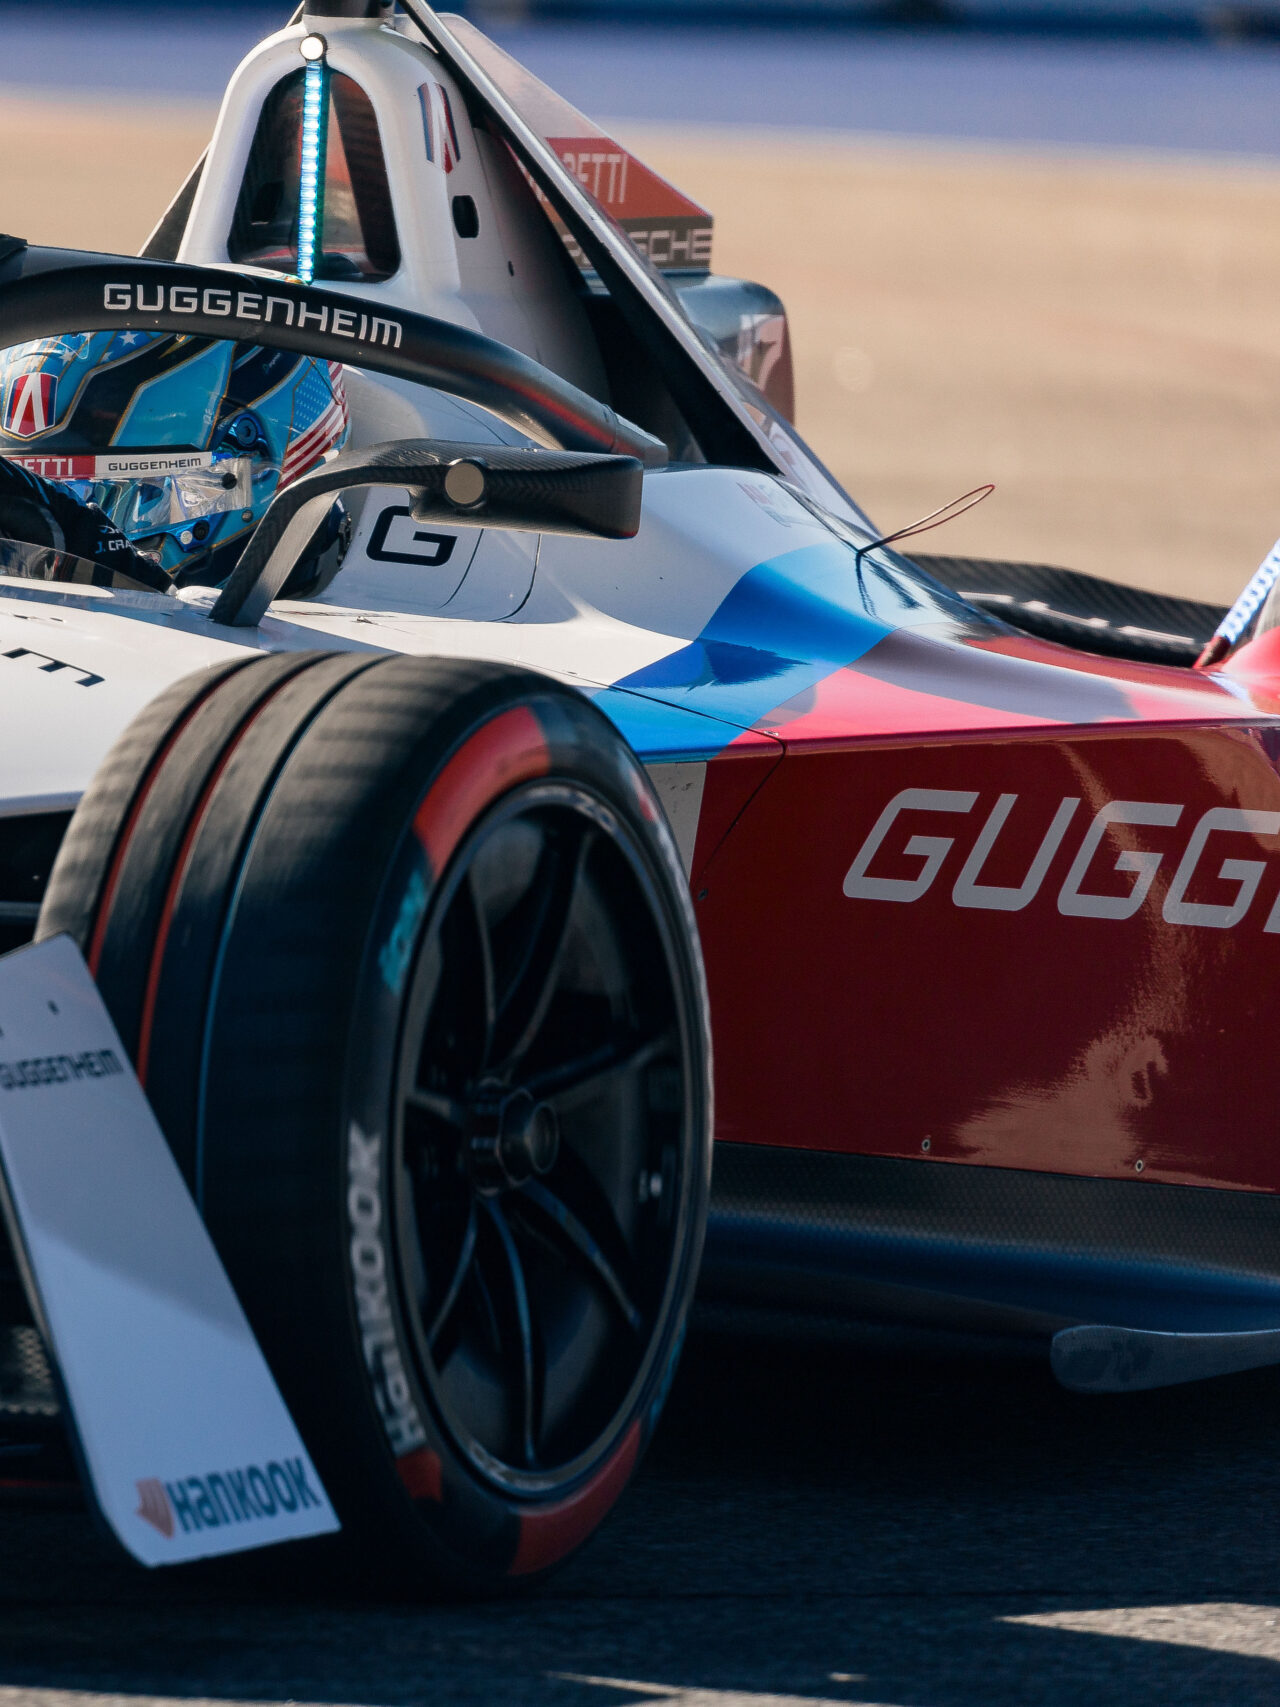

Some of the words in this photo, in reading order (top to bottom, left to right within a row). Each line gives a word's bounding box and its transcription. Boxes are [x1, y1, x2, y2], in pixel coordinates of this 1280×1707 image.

[104, 283, 403, 348] GUGGENHEIM
[108, 457, 202, 471] GUGGENHEIM
[108, 539, 133, 551] CRA
[842, 787, 1280, 933] GUGG
